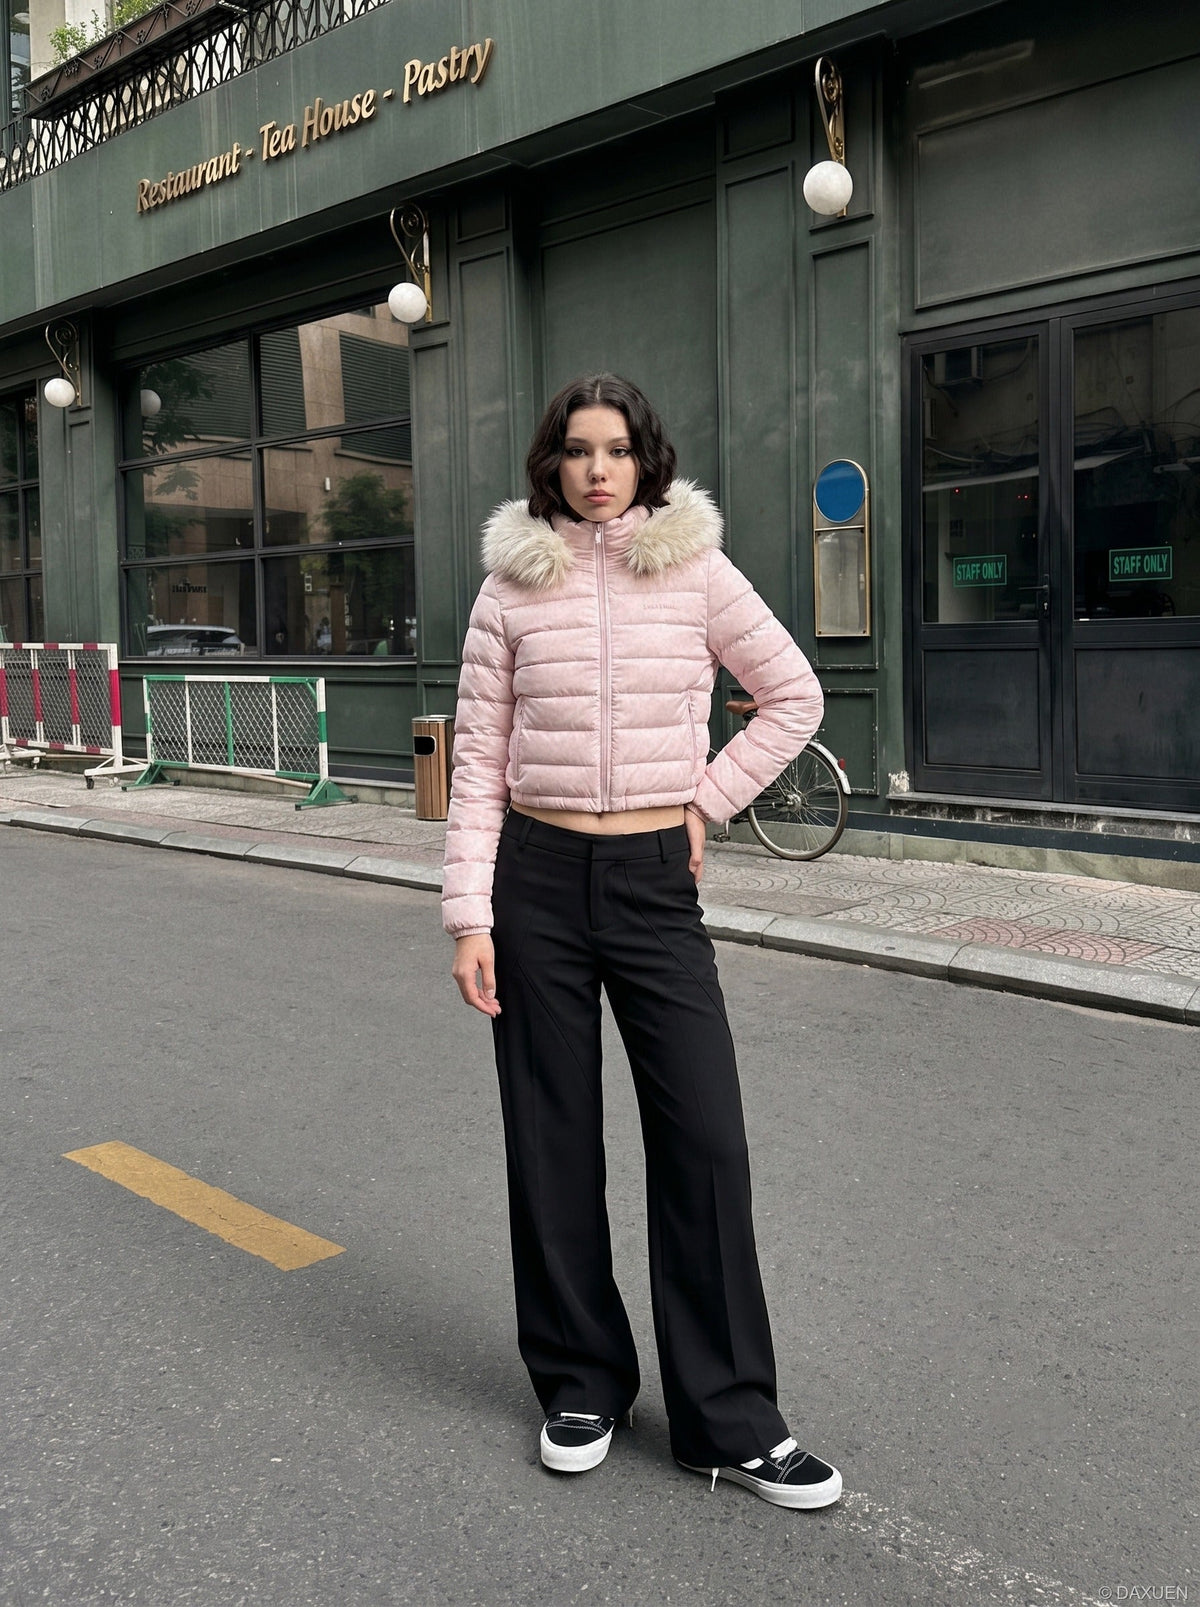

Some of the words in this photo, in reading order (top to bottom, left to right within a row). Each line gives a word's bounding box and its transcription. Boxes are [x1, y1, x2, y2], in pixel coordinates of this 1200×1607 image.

[136, 142, 241, 213] Restaurant
[259, 120, 297, 162] Tea
[302, 88, 377, 147] House
[403, 38, 494, 104] Pastry
[956, 563, 981, 581] STAFF
[982, 561, 1003, 579] ONLY
[1113, 556, 1141, 575] STAFF
[1143, 554, 1168, 573] ONLY
